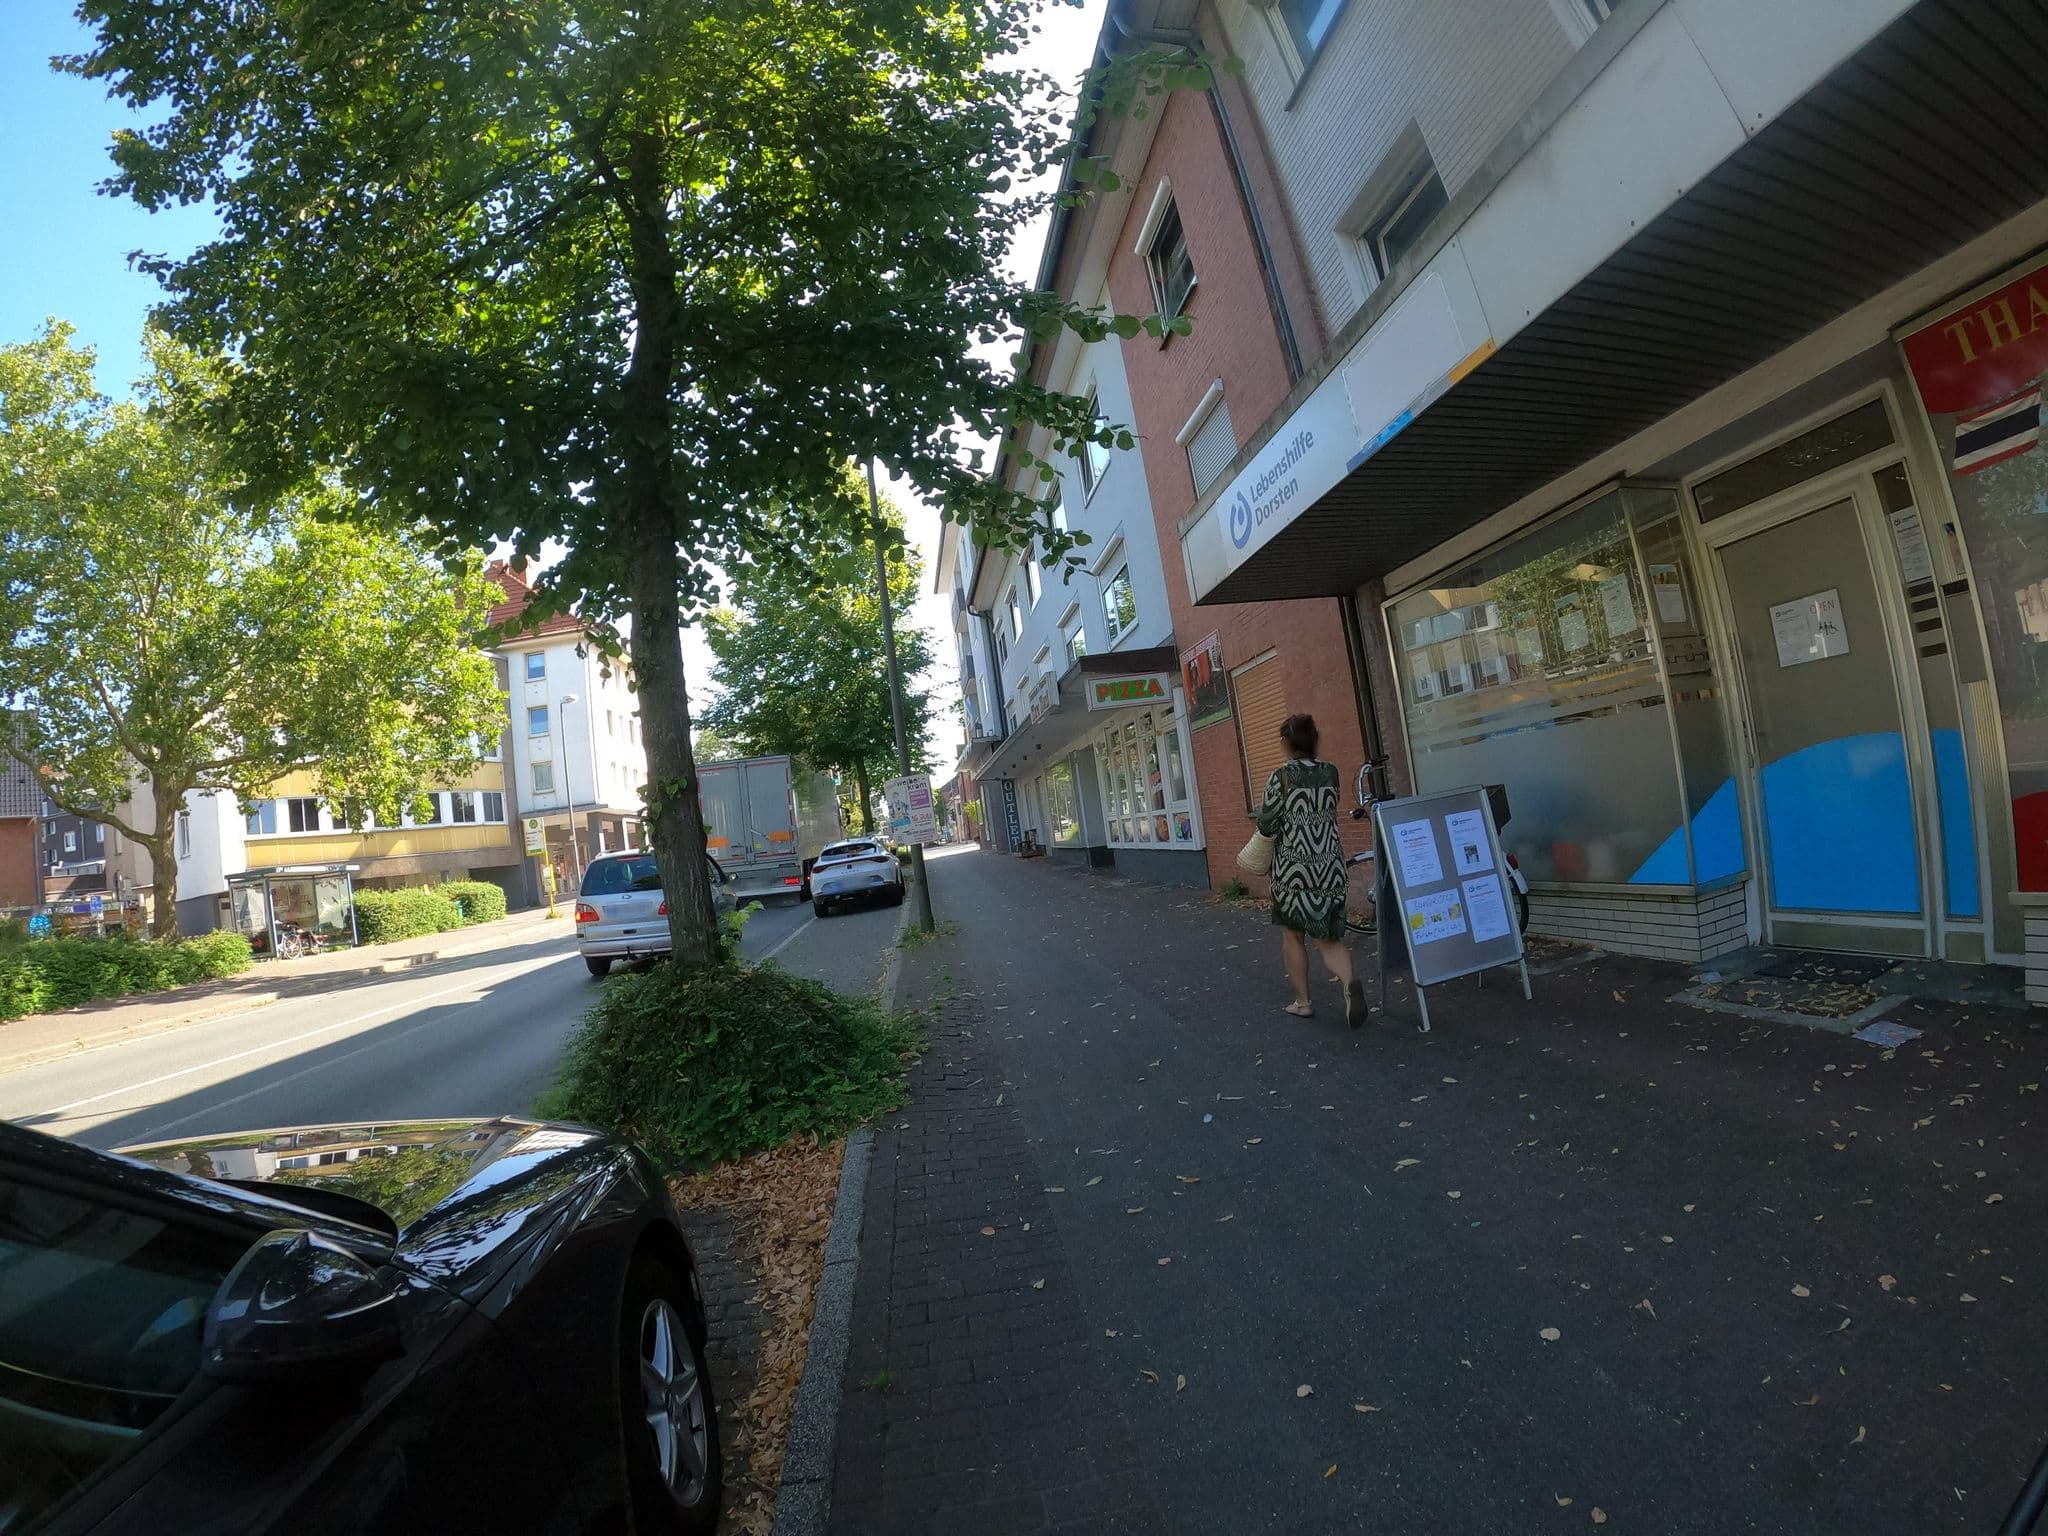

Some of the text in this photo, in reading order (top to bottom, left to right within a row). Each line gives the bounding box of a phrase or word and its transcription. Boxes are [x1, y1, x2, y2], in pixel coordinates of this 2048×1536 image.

[1250, 430, 1314, 503] Lebenshilfe
[1254, 478, 1299, 526] Dorsten
[1096, 678, 1165, 702] PIZZA
[1004, 781, 1019, 846] OUTLET
